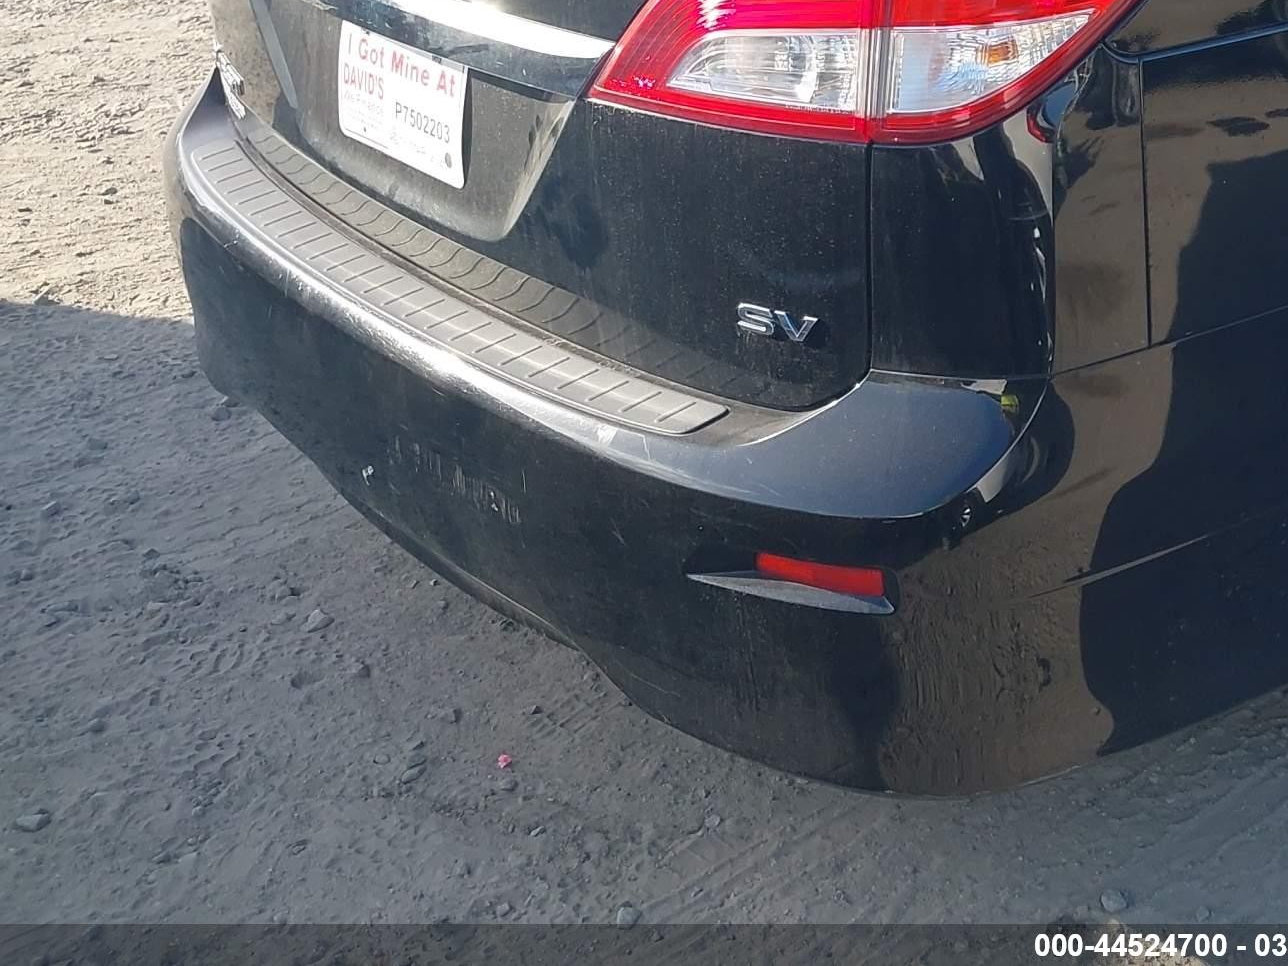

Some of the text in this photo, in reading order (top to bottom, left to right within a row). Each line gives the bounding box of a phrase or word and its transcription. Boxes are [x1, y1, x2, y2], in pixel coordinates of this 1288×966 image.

[343, 62, 385, 101] DAVID'S
[347, 33, 457, 98] I Got Mine At
[395, 101, 451, 144] P7502203
[737, 302, 819, 342] SV
